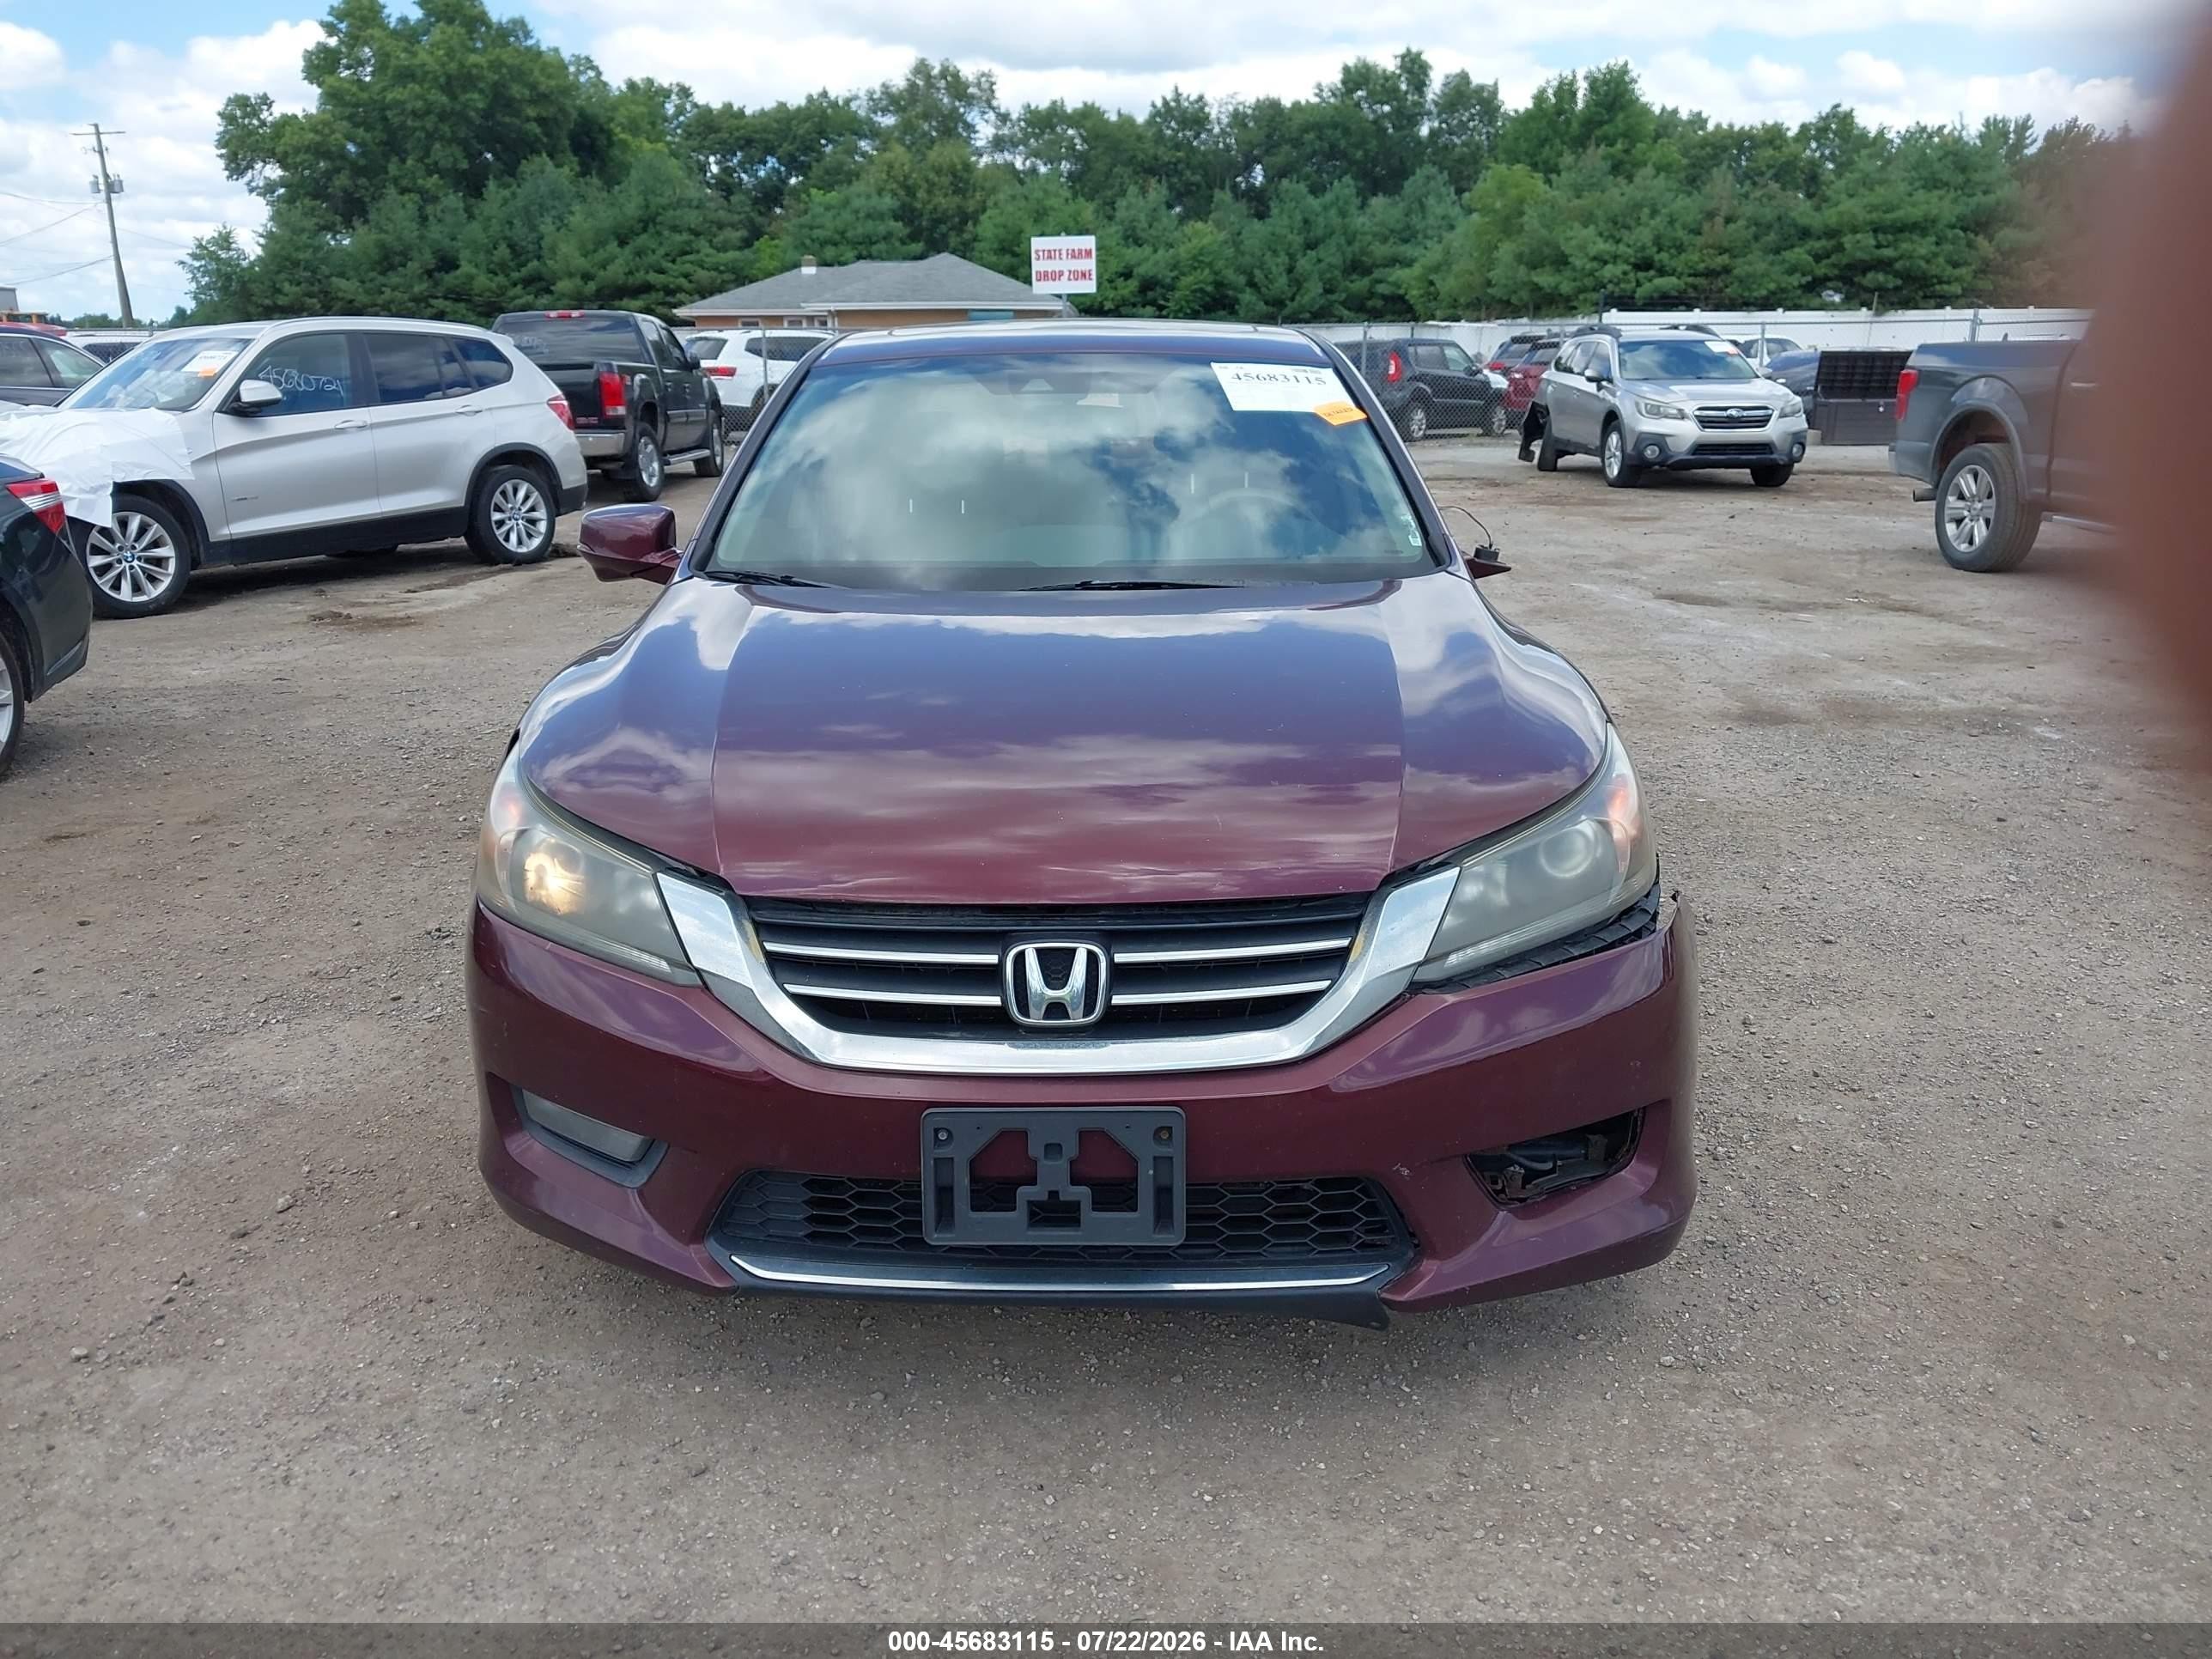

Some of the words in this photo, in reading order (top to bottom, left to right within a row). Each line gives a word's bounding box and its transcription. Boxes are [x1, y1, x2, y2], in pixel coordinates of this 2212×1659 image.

[1034, 248, 1063, 261] STATE
[1066, 247, 1092, 260] FARM
[1036, 270, 1064, 282] DROP
[1067, 269, 1092, 281] ZONE
[1231, 373, 1327, 386] 45683115
